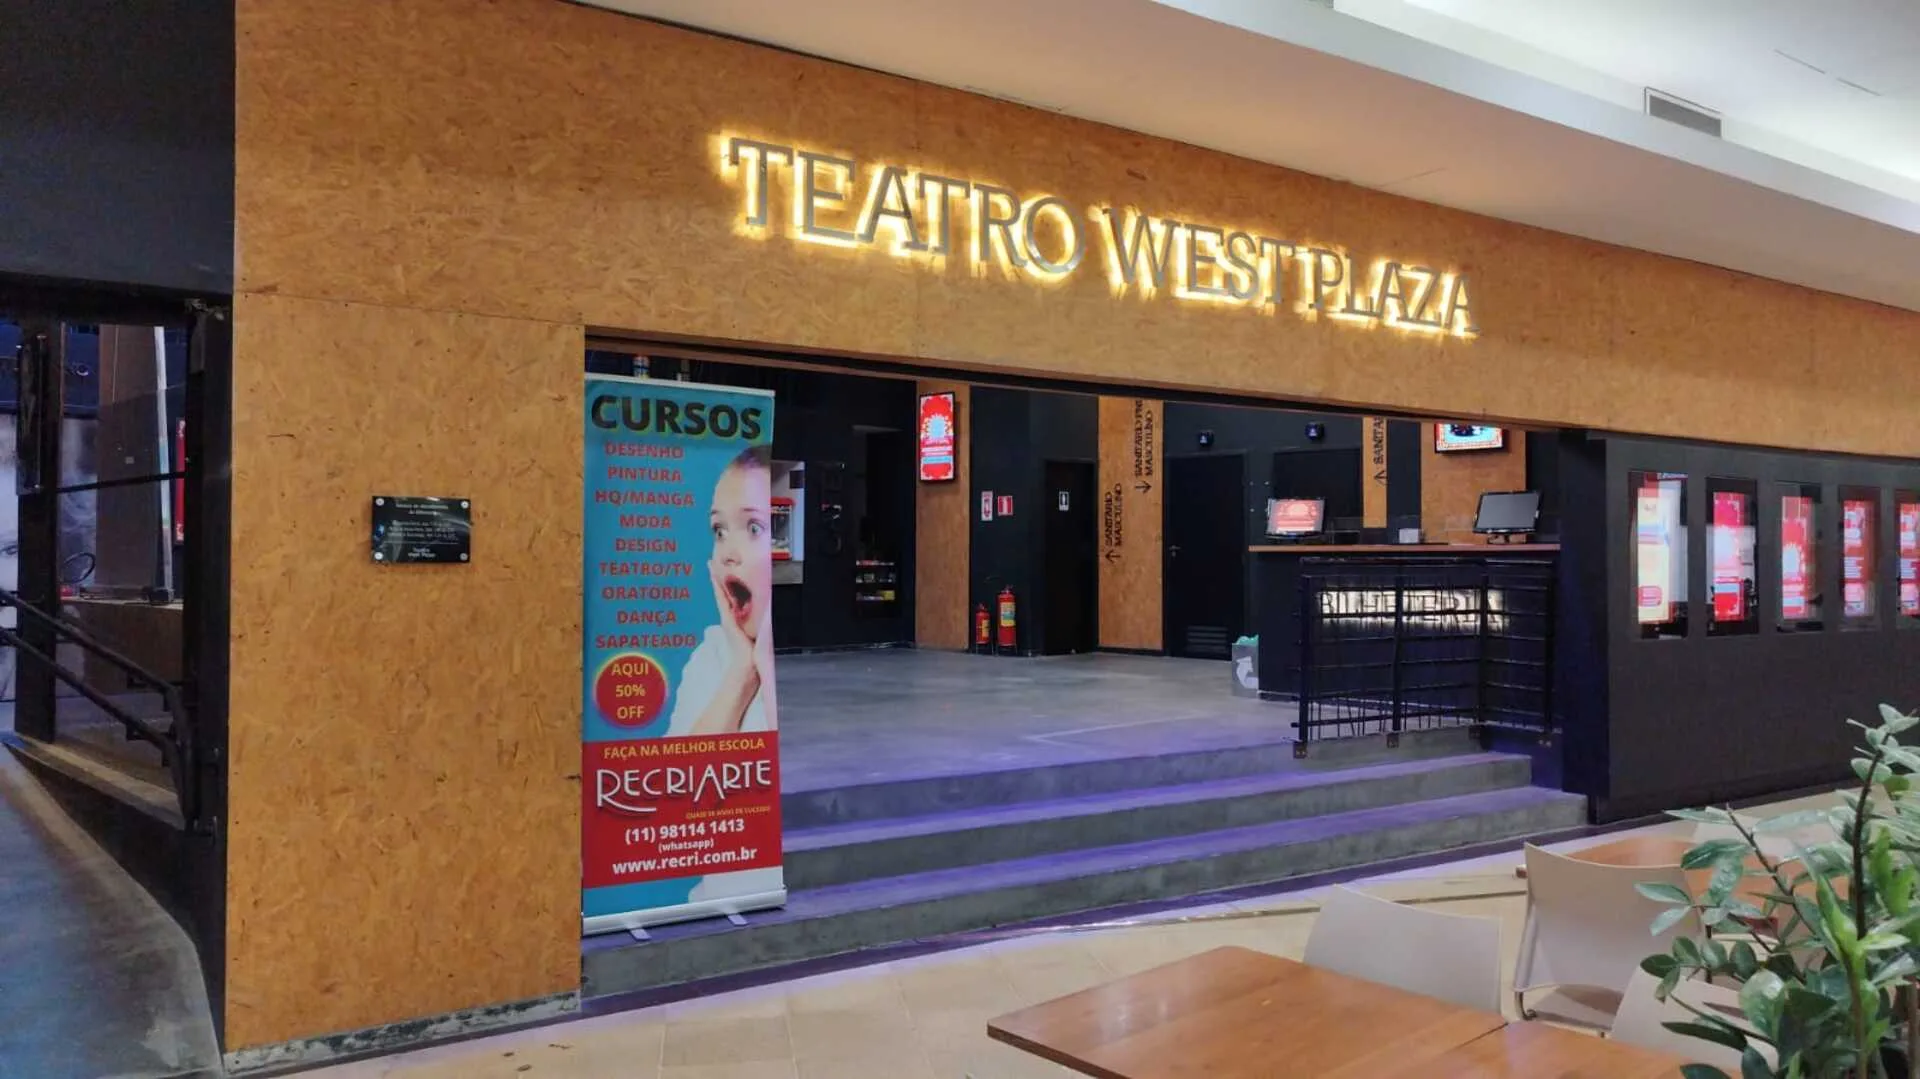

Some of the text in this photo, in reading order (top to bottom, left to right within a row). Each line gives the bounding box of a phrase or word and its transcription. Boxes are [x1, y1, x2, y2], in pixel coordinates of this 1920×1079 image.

[728, 137, 1480, 333] TEATRO WEST PLAZA
[591, 394, 762, 440] CURSOS
[604, 443, 684, 459] DESENHO
[607, 466, 682, 482] PINTURA
[595, 490, 694, 506] HQ/MANGA
[620, 514, 672, 529] MODA
[615, 538, 677, 553] DESIGN
[599, 561, 692, 577] TEATRO/TV
[617, 610, 676, 627] DANÇA
[596, 634, 697, 649] SAPATEADO
[611, 662, 649, 677] AQUI
[615, 684, 646, 697] 50%
[616, 704, 645, 719] OFF
[604, 738, 766, 760] FAÇA NA MELHOR ESCOLA
[596, 760, 772, 812] RECRIARTE
[625, 819, 745, 845] (11) 98114 1413
[658, 838, 714, 854] (whatsapp)
[612, 847, 758, 874] www.recri.com.br
